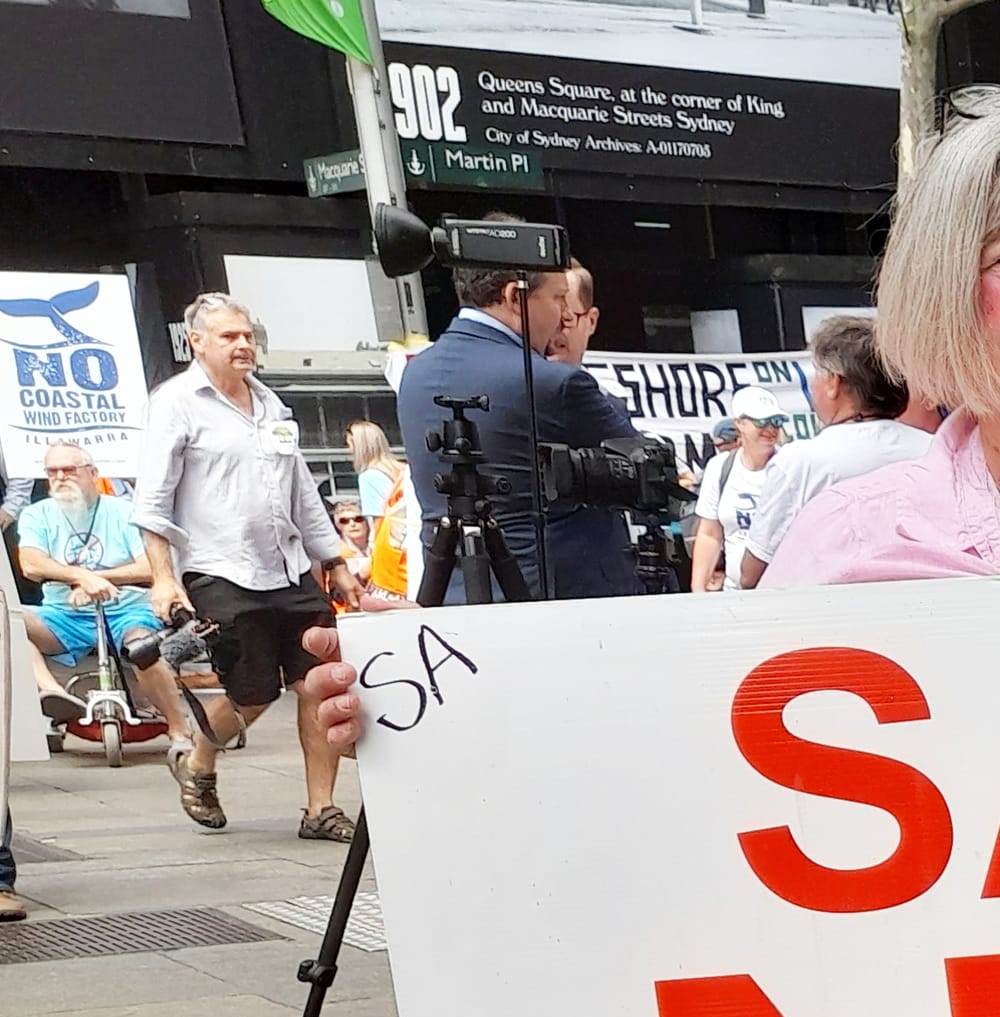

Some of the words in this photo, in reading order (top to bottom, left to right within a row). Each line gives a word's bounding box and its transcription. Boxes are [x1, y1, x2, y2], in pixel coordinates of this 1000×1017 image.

[478, 71, 545, 94] Queens
[549, 77, 615, 101] Square,
[620, 87, 636, 103] at
[641, 86, 667, 105] the
[671, 93, 722, 111] corner
[727, 95, 743, 112] of
[746, 95, 786, 118] King
[481, 97, 515, 115] and
[521, 97, 609, 122] Macquarie
[613, 105, 673, 128] Streets
[676, 110, 736, 135] Sydney
[485, 127, 512, 145] City
[516, 130, 531, 145] of
[532, 130, 581, 150] Sydney
[317, 157, 359, 183] Macquarie
[445, 149, 507, 172] Martin
[512, 153, 529, 173] Pl
[12, 347, 119, 392] NO
[752, 361, 792, 382] ON
[19, 389, 126, 410] COASTAL
[23, 410, 61, 426] WIND
[64, 411, 126, 425] FACTORY
[360, 624, 478, 732] SA
